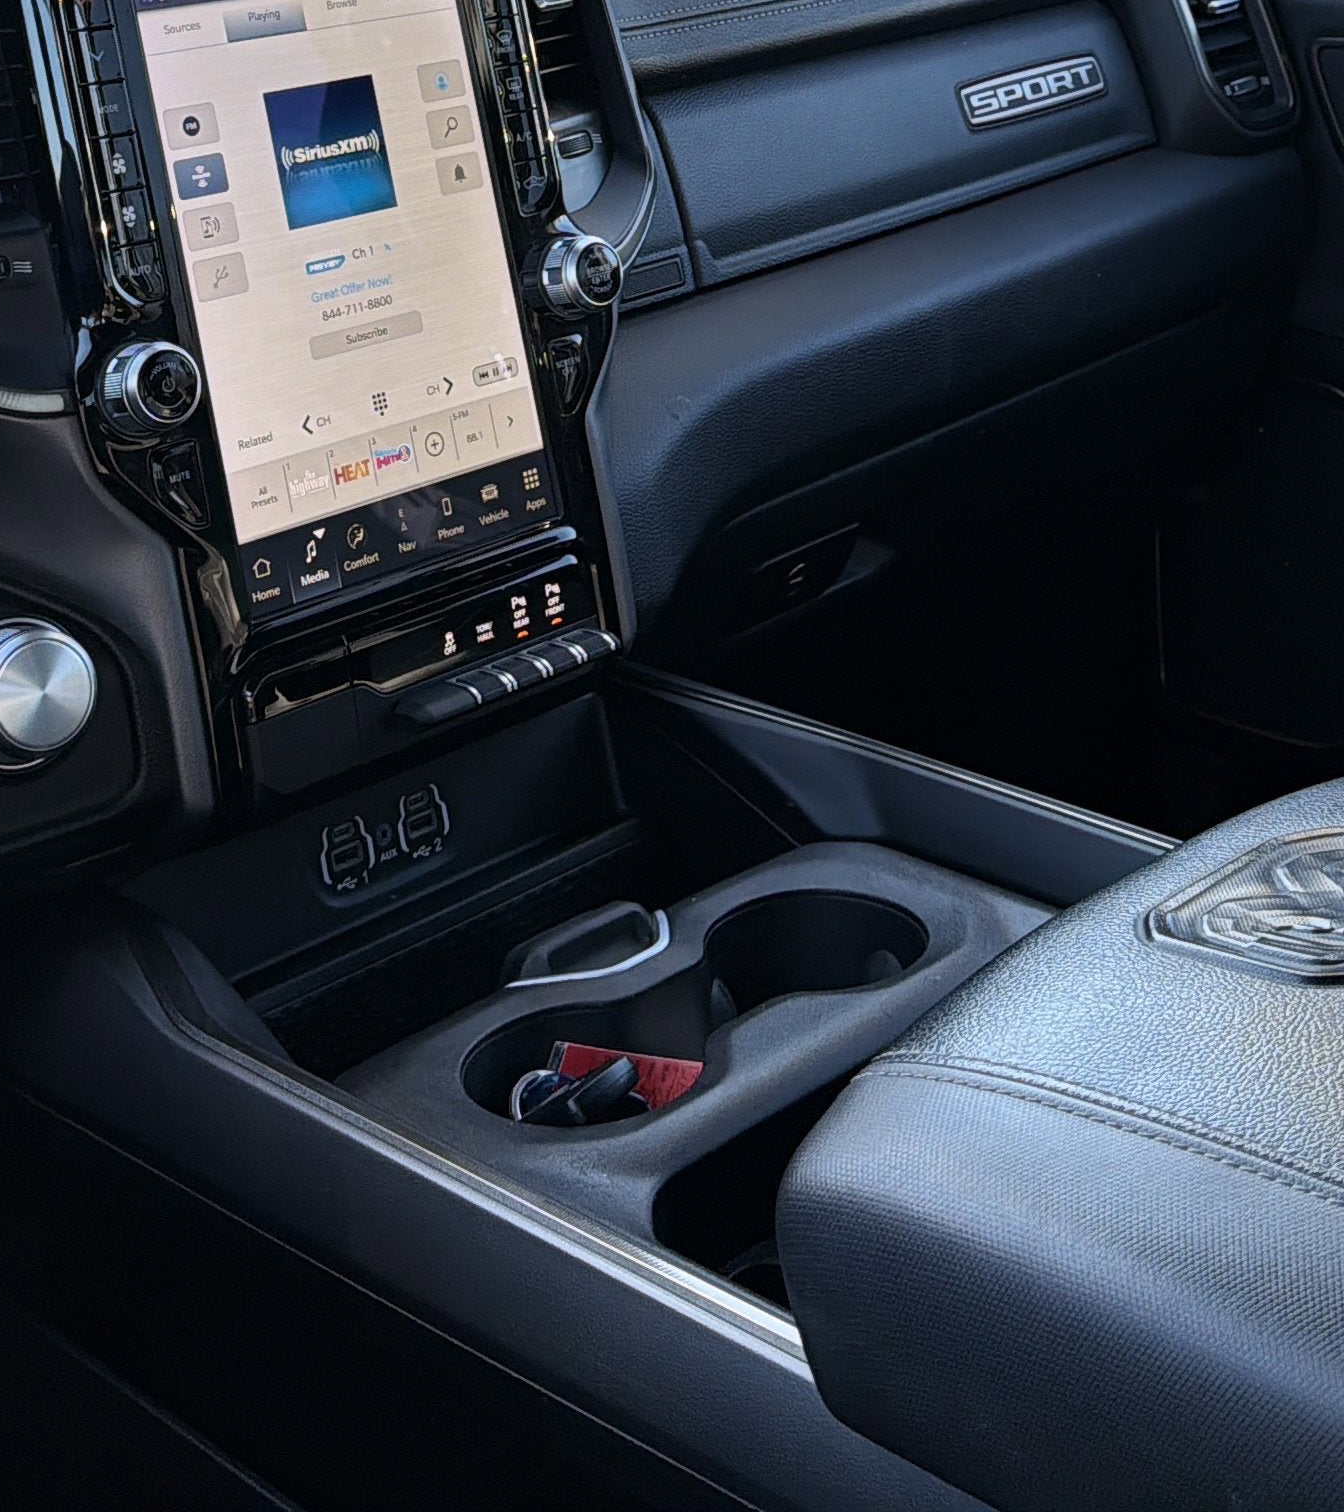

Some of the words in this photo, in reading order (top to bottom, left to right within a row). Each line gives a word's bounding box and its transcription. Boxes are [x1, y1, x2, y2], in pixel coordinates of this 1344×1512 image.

[247, 7, 281, 24] Playing
[163, 20, 202, 35] Sources
[969, 63, 1094, 116] SPORT
[185, 122, 198, 131] FM
[351, 247, 367, 260] Ch
[310, 288, 338, 303] Great
[340, 281, 366, 297] Offer
[367, 273, 394, 289] Now!
[321, 294, 394, 322] 844-711-8800
[345, 326, 389, 345] Subscribe
[426, 384, 441, 396] CH
[316, 415, 332, 428] CH
[237, 430, 274, 452] Related
[168, 469, 192, 485] MUTE
[333, 458, 371, 486] HEAT
[258, 485, 268, 497] All
[288, 473, 330, 497] highway
[250, 494, 279, 510] Presets
[525, 495, 548, 512] Apps
[478, 508, 510, 527] Vehicle
[437, 523, 465, 541] Phone
[397, 539, 418, 554] Nav
[343, 551, 380, 573] Comfort
[300, 568, 331, 587] Media
[251, 585, 281, 604] Home
[548, 595, 561, 607] OFF
[513, 608, 527, 620] OFF
[545, 602, 566, 617] FRONT
[512, 616, 531, 630] REAR
[444, 645, 457, 656] OFF
[433, 837, 443, 853] 2
[380, 848, 399, 863] AUX
